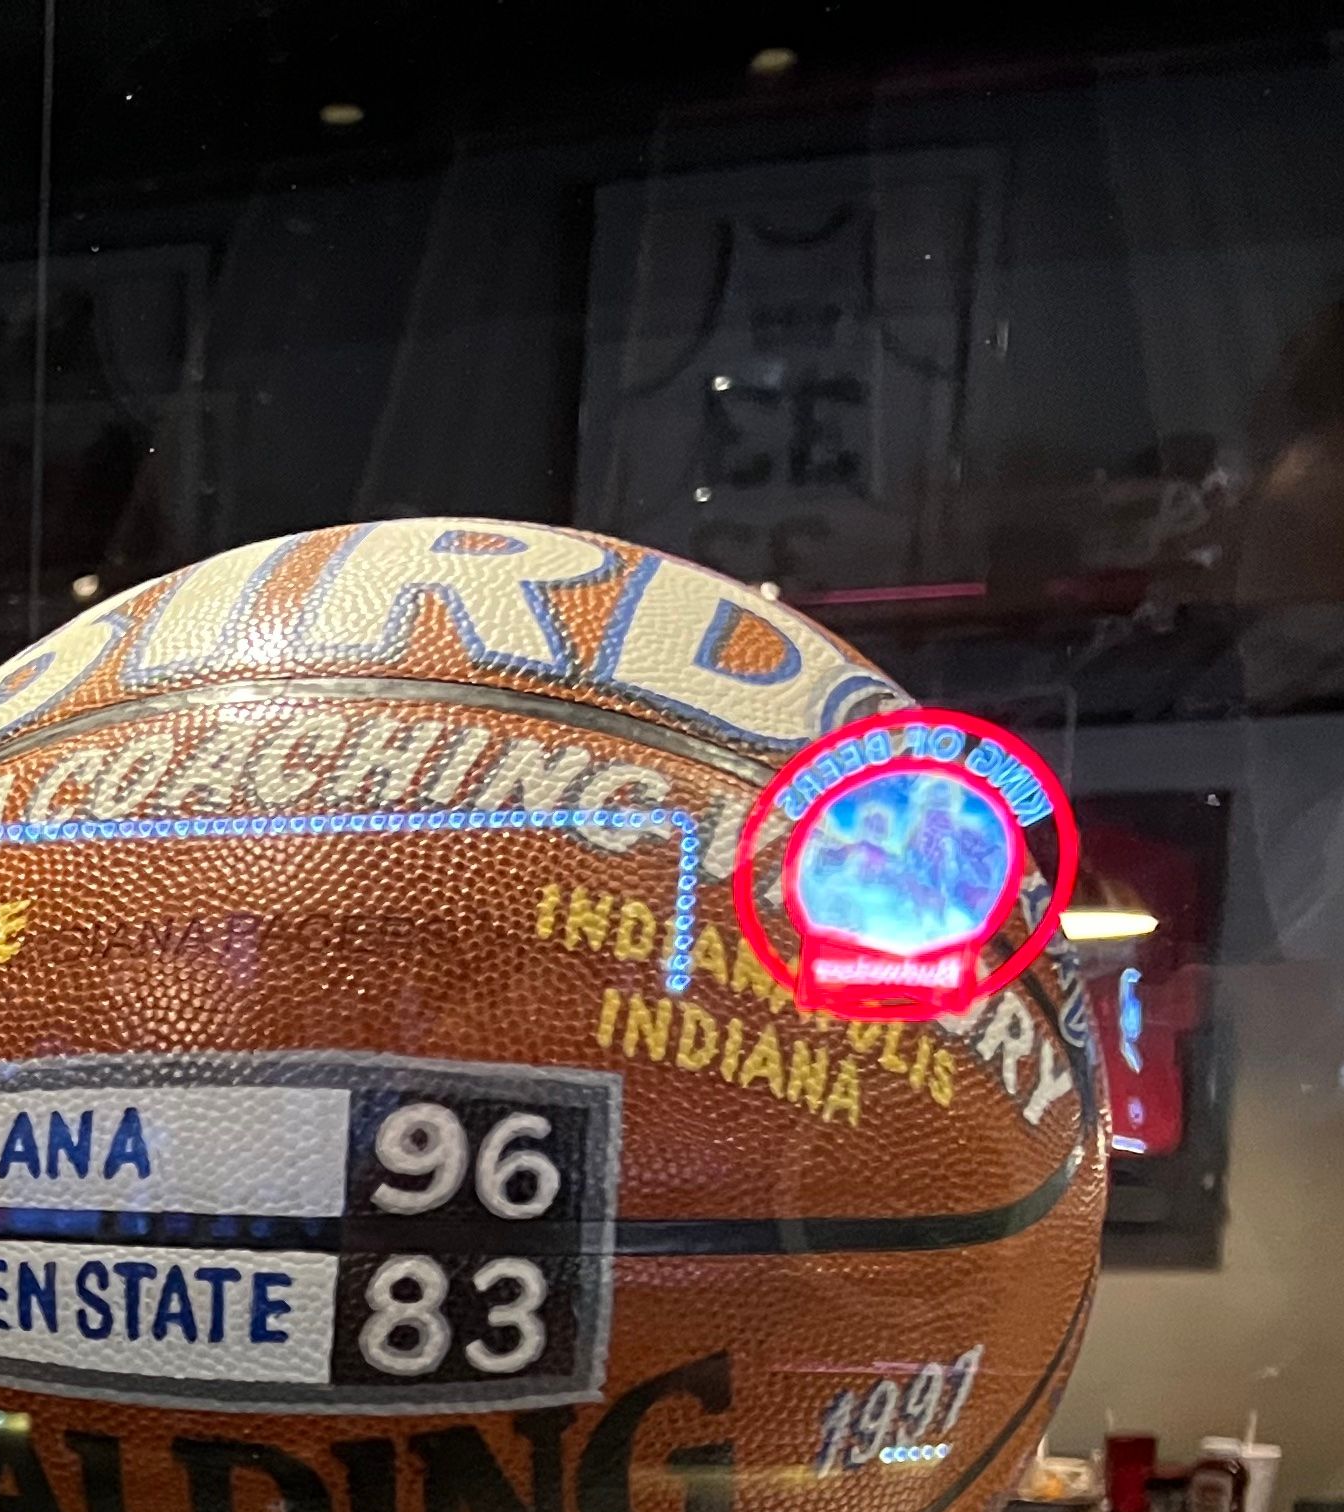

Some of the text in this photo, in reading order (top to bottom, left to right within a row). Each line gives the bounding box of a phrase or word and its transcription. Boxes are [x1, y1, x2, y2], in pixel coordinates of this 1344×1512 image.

[31, 714, 677, 856] COACHING
[596, 989, 861, 1128] INDIANA
[371, 1103, 564, 1220] 96
[75, 1258, 297, 1347] STATE
[363, 1255, 550, 1378] 83
